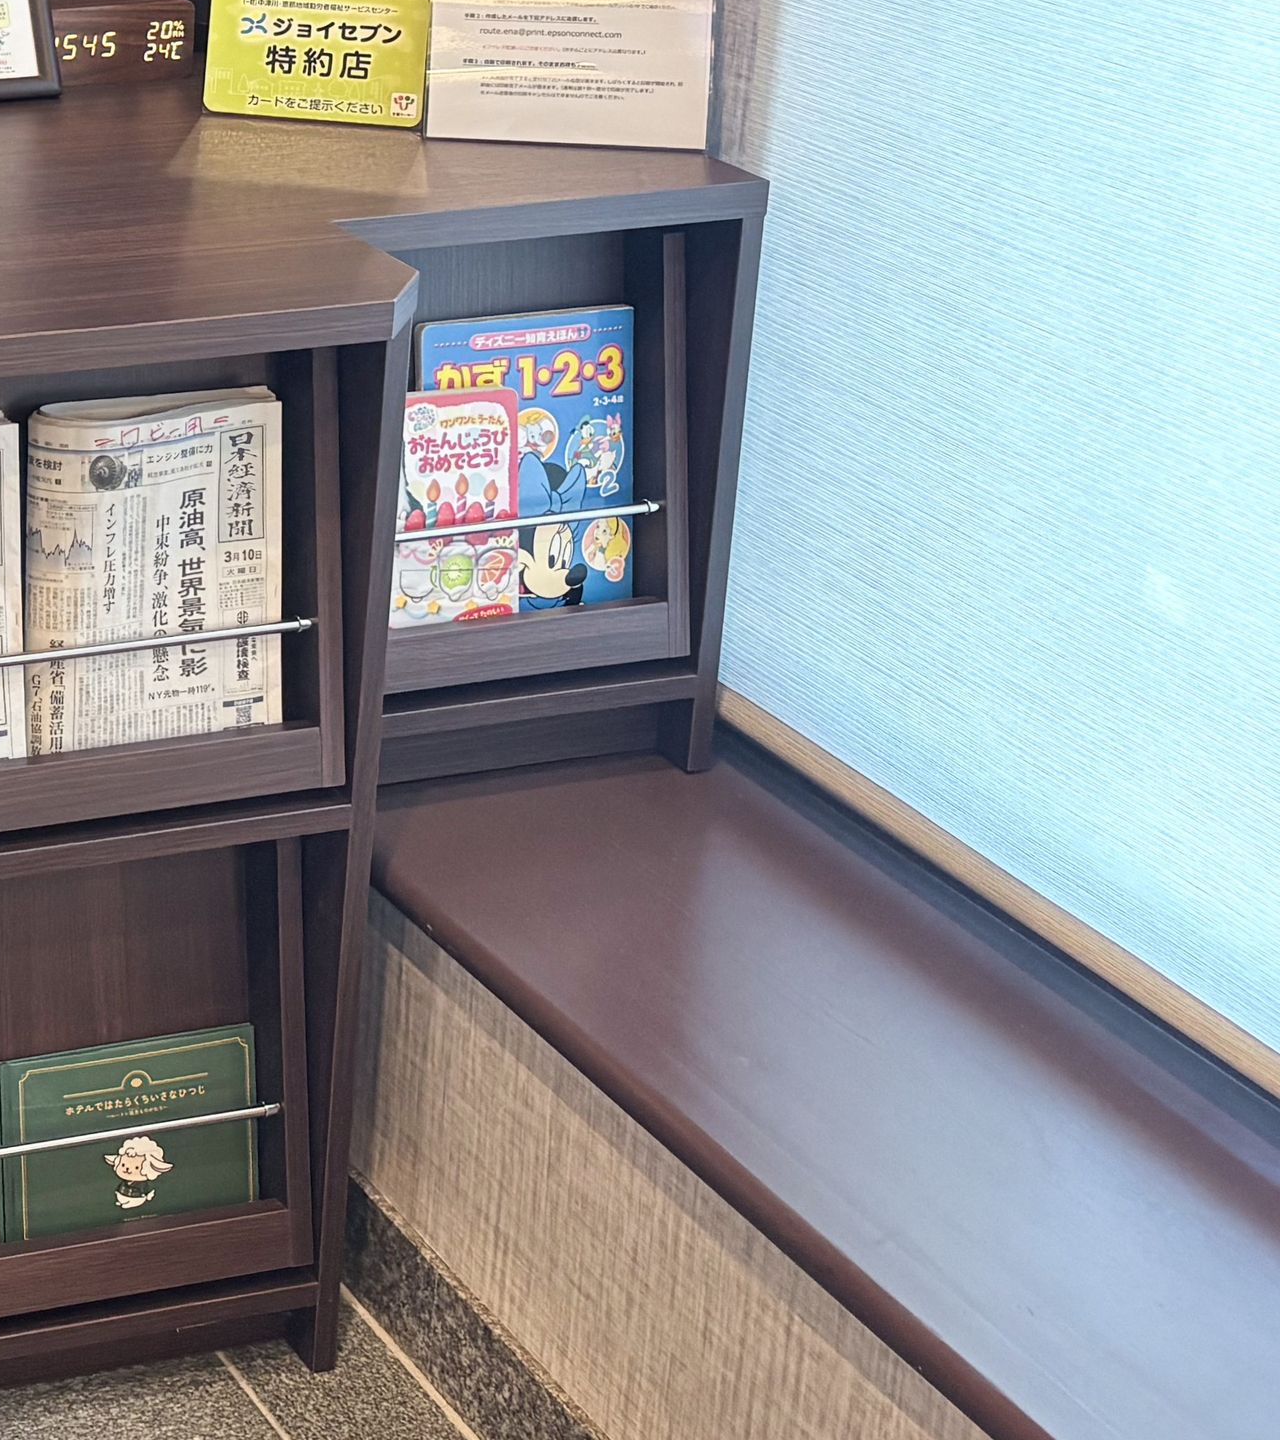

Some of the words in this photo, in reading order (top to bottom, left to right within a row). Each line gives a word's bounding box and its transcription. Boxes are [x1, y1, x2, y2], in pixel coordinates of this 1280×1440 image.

[273, 16, 403, 45] ジョイセブン
[479, 27, 623, 39] route.ena@print.epsonconnect.com
[265, 44, 373, 81] 特約店
[247, 93, 384, 116] カードをご提示ください
[474, 328, 579, 349] ディズニー知育えほん
[407, 426, 509, 455] おたんじょうび
[146, 444, 213, 465] エンジン整備に力
[418, 446, 500, 474] おめでとう!
[103, 502, 118, 615] インフレ圧力増す
[224, 548, 262, 563] 3月10日
[226, 565, 257, 576] 火曜日
[65, 1085, 206, 1116] ホテルではたらくちいさなひつじ
